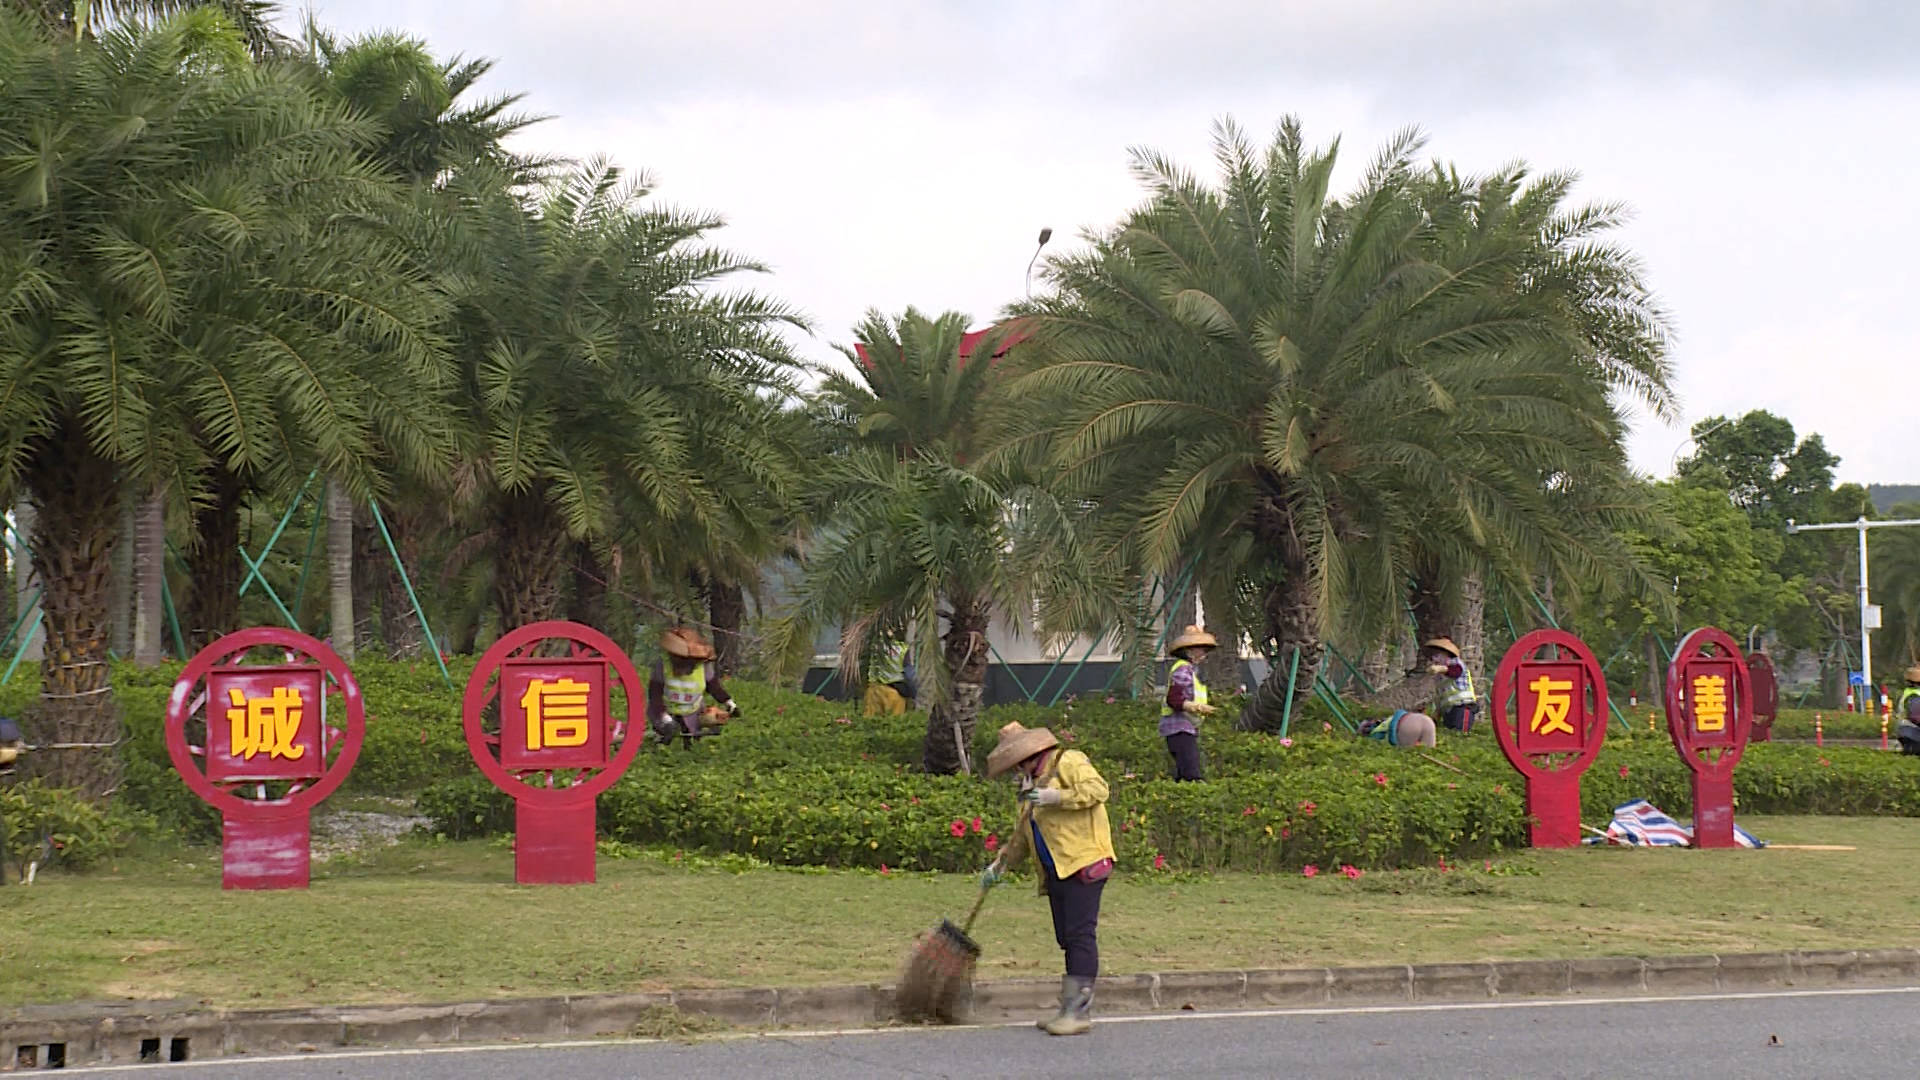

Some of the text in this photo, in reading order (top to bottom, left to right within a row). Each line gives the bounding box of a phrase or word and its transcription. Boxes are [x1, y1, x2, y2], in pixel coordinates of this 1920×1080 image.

[227, 687, 304, 759] 诚
[520, 678, 589, 750] 信
[1530, 676, 1574, 735] 友
[1693, 675, 1727, 731] 善
